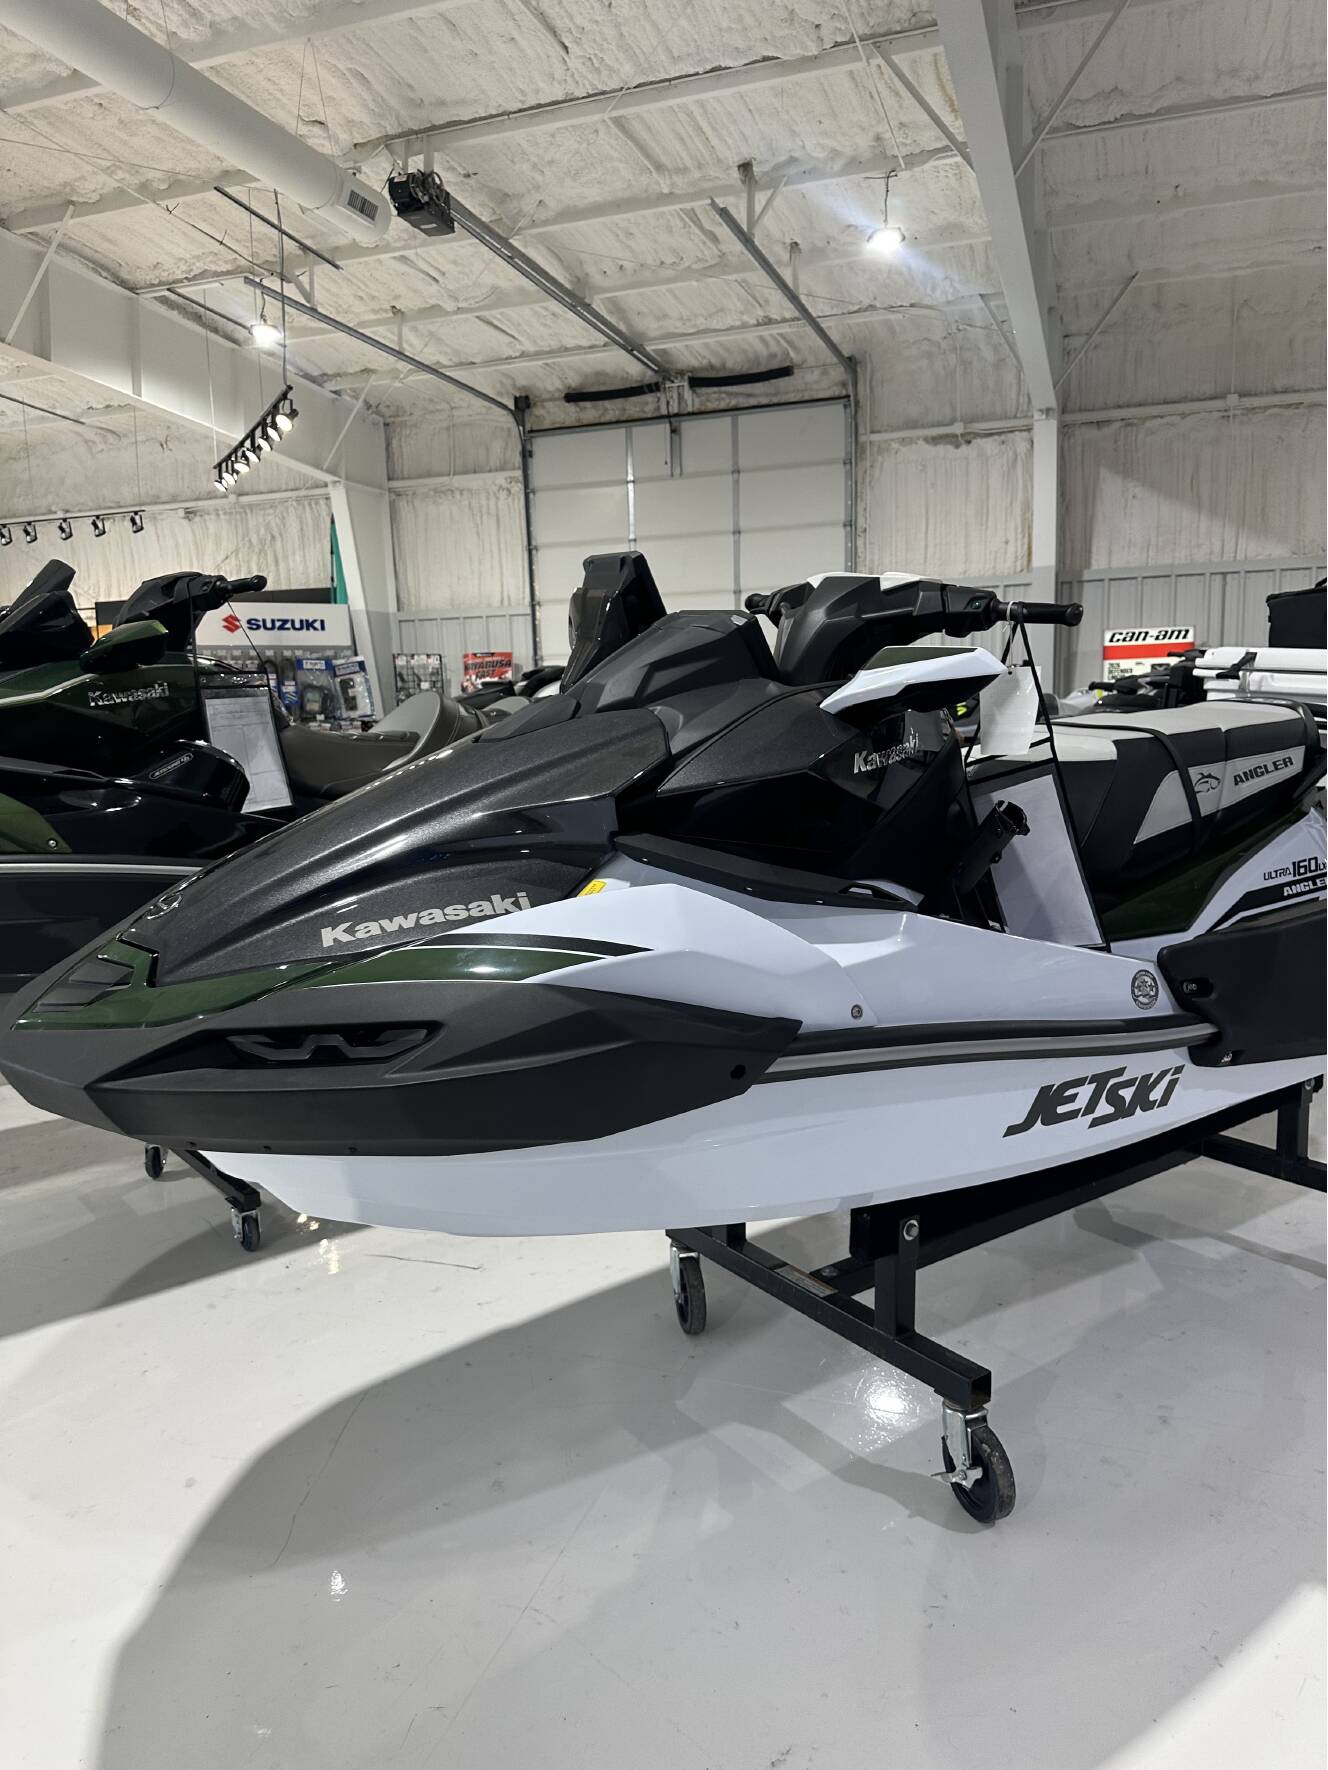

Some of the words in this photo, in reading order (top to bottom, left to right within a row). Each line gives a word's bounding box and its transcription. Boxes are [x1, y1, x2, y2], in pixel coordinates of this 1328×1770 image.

[246, 618, 326, 631] SUZUKI
[88, 681, 169, 706] Kawasaki
[854, 732, 919, 774] Kawasaki
[1233, 756, 1294, 786] ANGLER
[1283, 877, 1326, 897] ANGLE
[320, 891, 531, 947] Kawasaki
